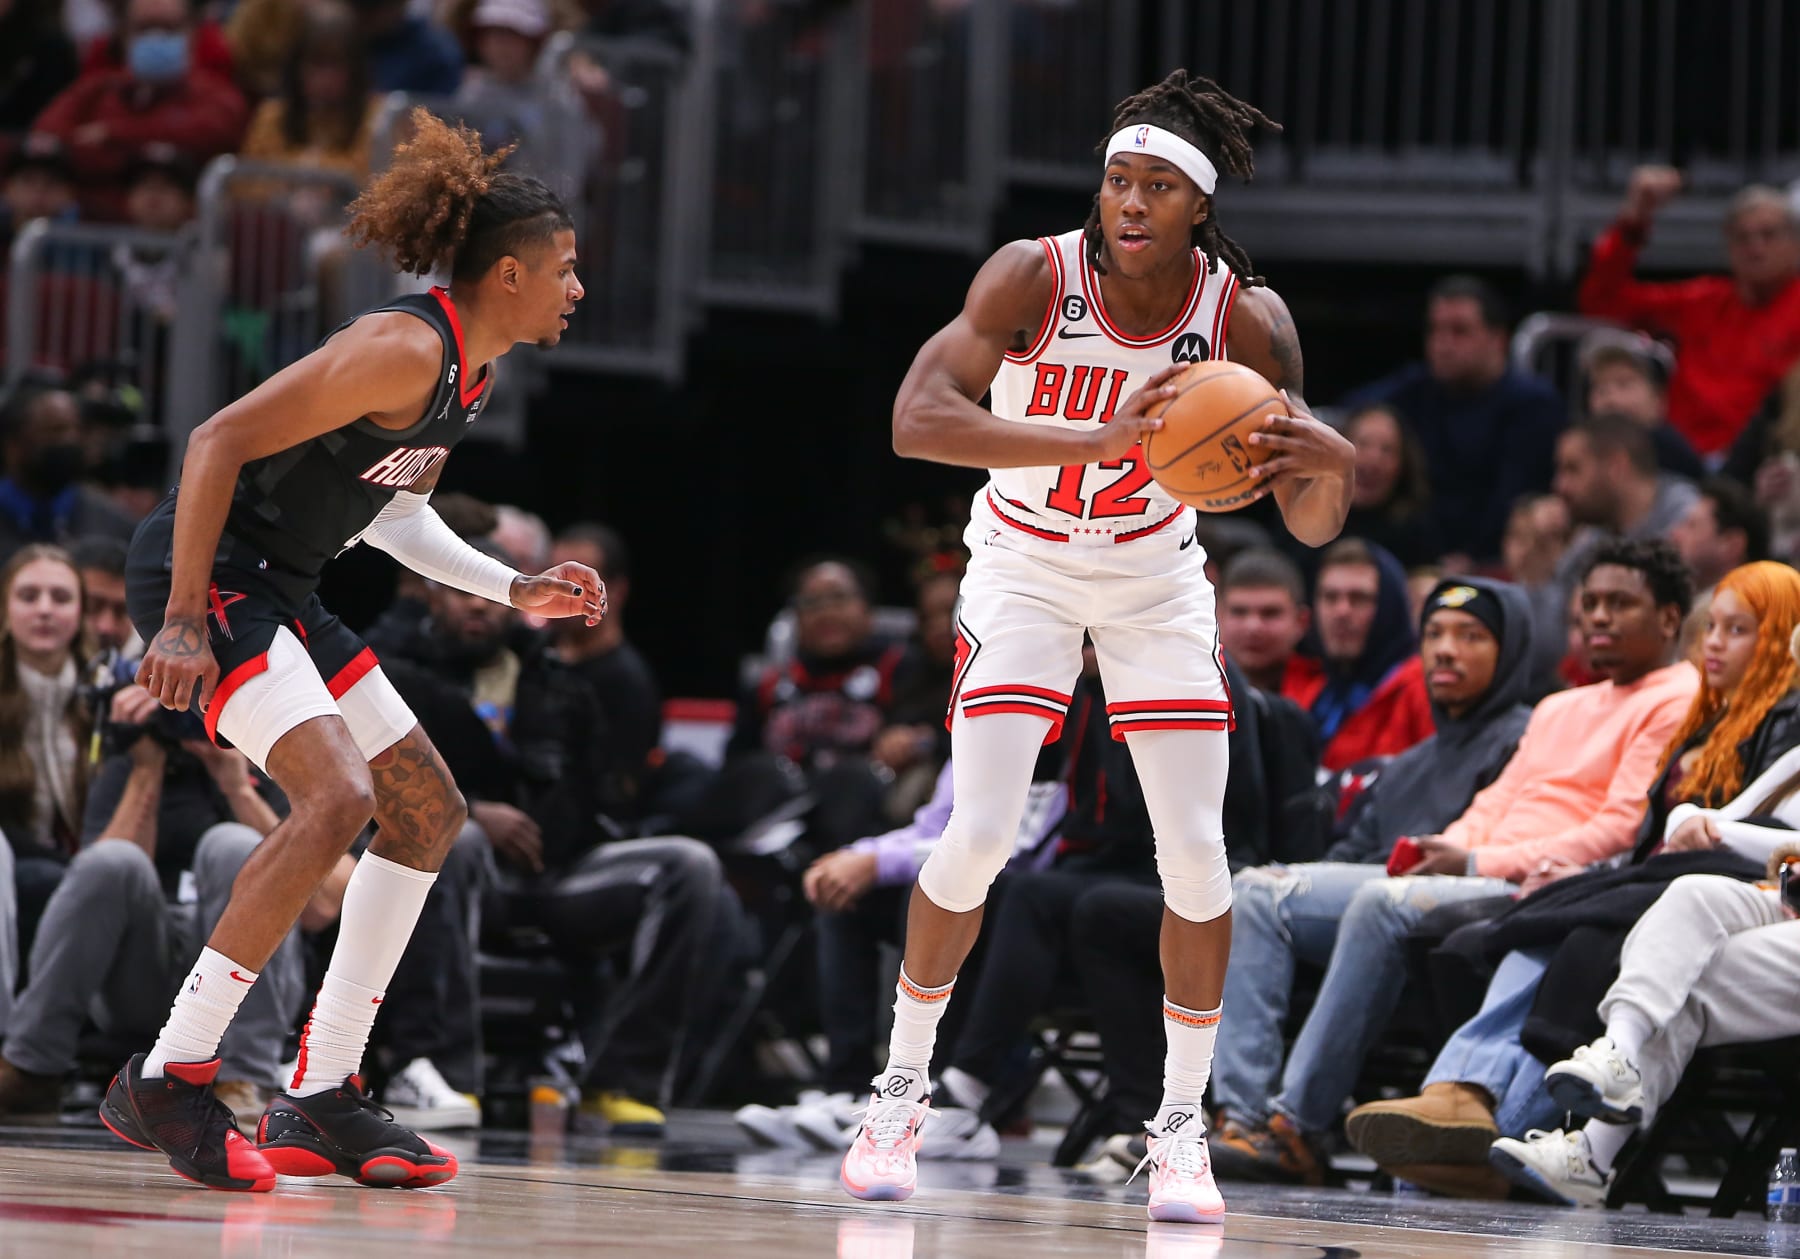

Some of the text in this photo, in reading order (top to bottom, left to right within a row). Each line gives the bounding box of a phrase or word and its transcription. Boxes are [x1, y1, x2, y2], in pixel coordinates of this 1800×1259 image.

[1066, 298, 1082, 319] 6
[447, 363, 458, 385] 6
[1025, 362, 1129, 424] BUL
[358, 445, 450, 488] HOUST
[1045, 442, 1155, 519] 12
